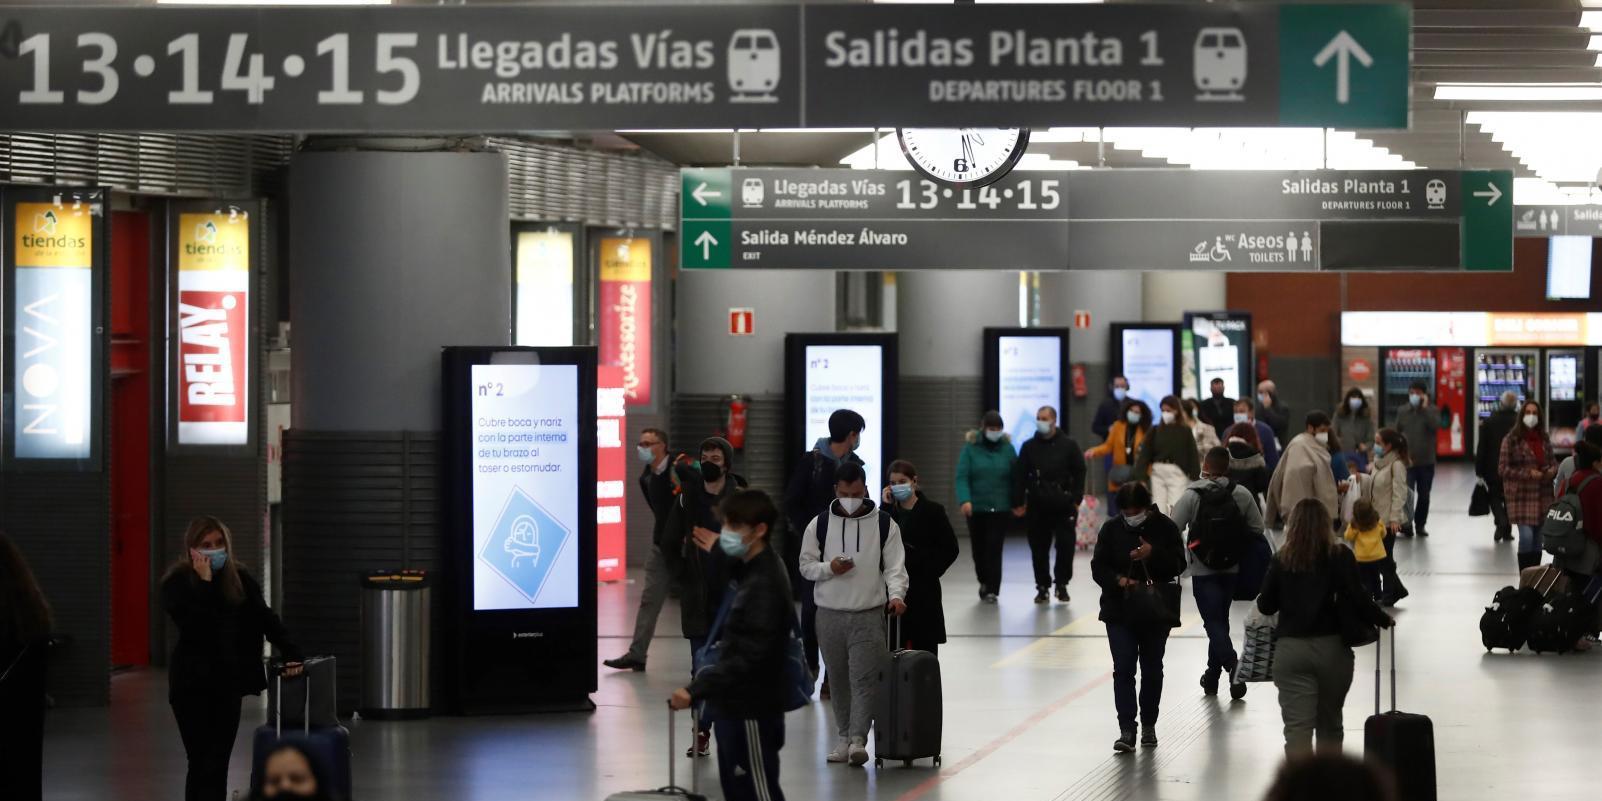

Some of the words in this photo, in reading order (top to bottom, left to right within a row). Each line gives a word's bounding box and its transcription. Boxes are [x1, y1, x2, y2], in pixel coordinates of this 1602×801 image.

[437, 33, 619, 78] Llegadas
[631, 30, 714, 70] Vías
[825, 29, 973, 67] Salidas
[989, 31, 1122, 67] Planta
[1140, 32, 1163, 66] 1
[482, 82, 584, 104] ARRIVALS
[590, 82, 714, 104] PLATFORMS
[930, 81, 1065, 101] DEPARTURES
[1073, 81, 1141, 101] FLOOR
[1150, 82, 1163, 100] 1
[953, 158, 969, 173] 6
[774, 179, 848, 198] Llegadas
[852, 178, 886, 195] Vías
[1282, 179, 1338, 194] Salidas
[1344, 179, 1396, 194] Planta
[1401, 180, 1411, 194] 1
[775, 199, 816, 209] ARRIVALS
[818, 199, 868, 209] PLATFORMS
[1322, 201, 1373, 210] DEPARTURES
[1377, 201, 1403, 210] FLOOR
[1405, 201, 1411, 210] 1
[22, 234, 86, 248] tiendas
[741, 231, 789, 245] Salida
[794, 230, 854, 245] Méndez
[859, 228, 908, 245] Álvaro
[1225, 234, 1235, 242] WC
[1238, 233, 1284, 250] Aseos
[743, 252, 761, 260] EXIT
[1249, 253, 1284, 263] TOILETS
[23, 292, 61, 434] NOVA
[496, 382, 504, 396] 2
[479, 417, 506, 427] Cubre
[508, 417, 532, 427] boca
[533, 419, 539, 429] y
[540, 417, 562, 427] nariz
[479, 434, 496, 442] con
[497, 433, 506, 442] la
[508, 433, 533, 444] parte
[535, 432, 567, 442] interna
[479, 448, 490, 457] de
[492, 449, 501, 457] tu
[503, 448, 529, 457] brazo
[531, 448, 539, 457] al
[479, 464, 501, 472] toser
[1546, 509, 1573, 521] FILA
